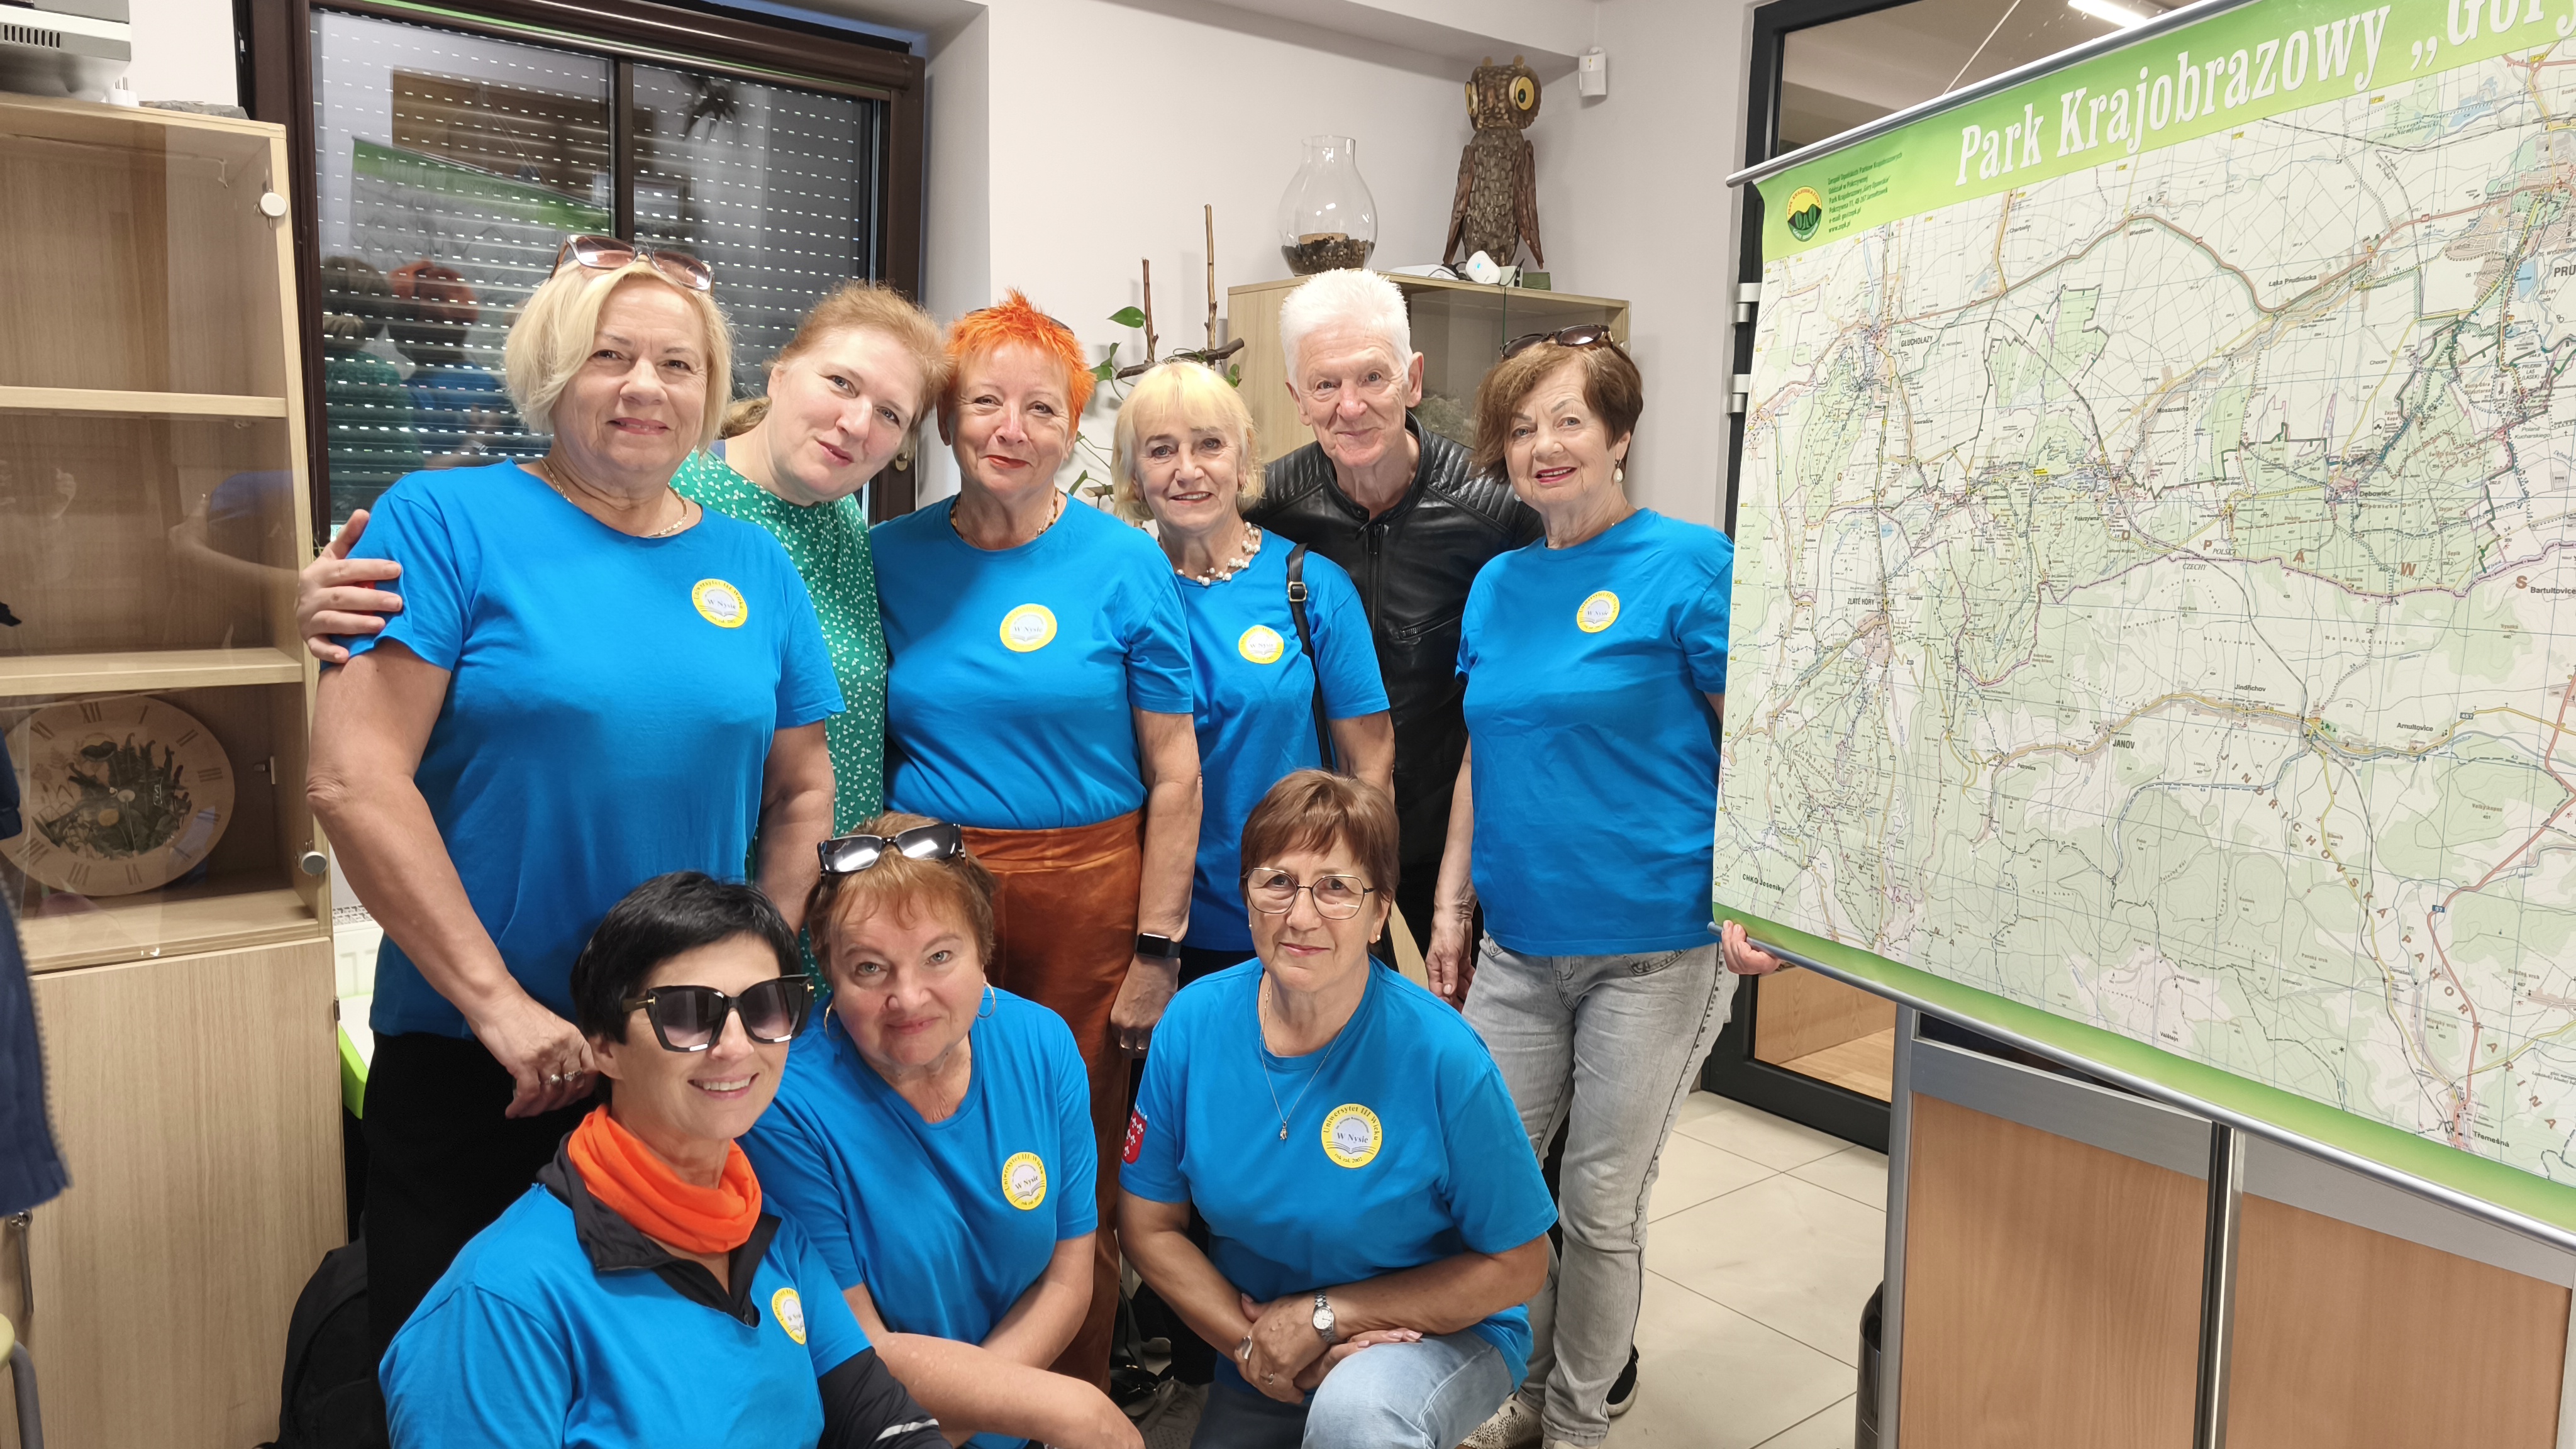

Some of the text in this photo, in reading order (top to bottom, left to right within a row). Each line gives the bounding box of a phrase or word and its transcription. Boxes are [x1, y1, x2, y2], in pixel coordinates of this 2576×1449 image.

[1955, 103, 2044, 186] Park
[2057, 5, 2391, 155] Krajobrazowy
[2285, 274, 2318, 284] Prudnicka
[2359, 490, 2392, 498] Dębowiec
[2212, 548, 2237, 556] POLSKA
[2235, 684, 2267, 692] Jindřichov
[2396, 722, 2434, 732] Arnultovice
[2112, 738, 2135, 749] JANOV
[1742, 874, 1759, 885] CHKO
[1323, 1106, 1358, 1133] Uniwersytet
[1361, 1108, 1371, 1118] III
[1370, 1116, 1380, 1140] Wieku
[1337, 1132, 1368, 1144] W Nysie
[2473, 1130, 2510, 1148] Třemešná
